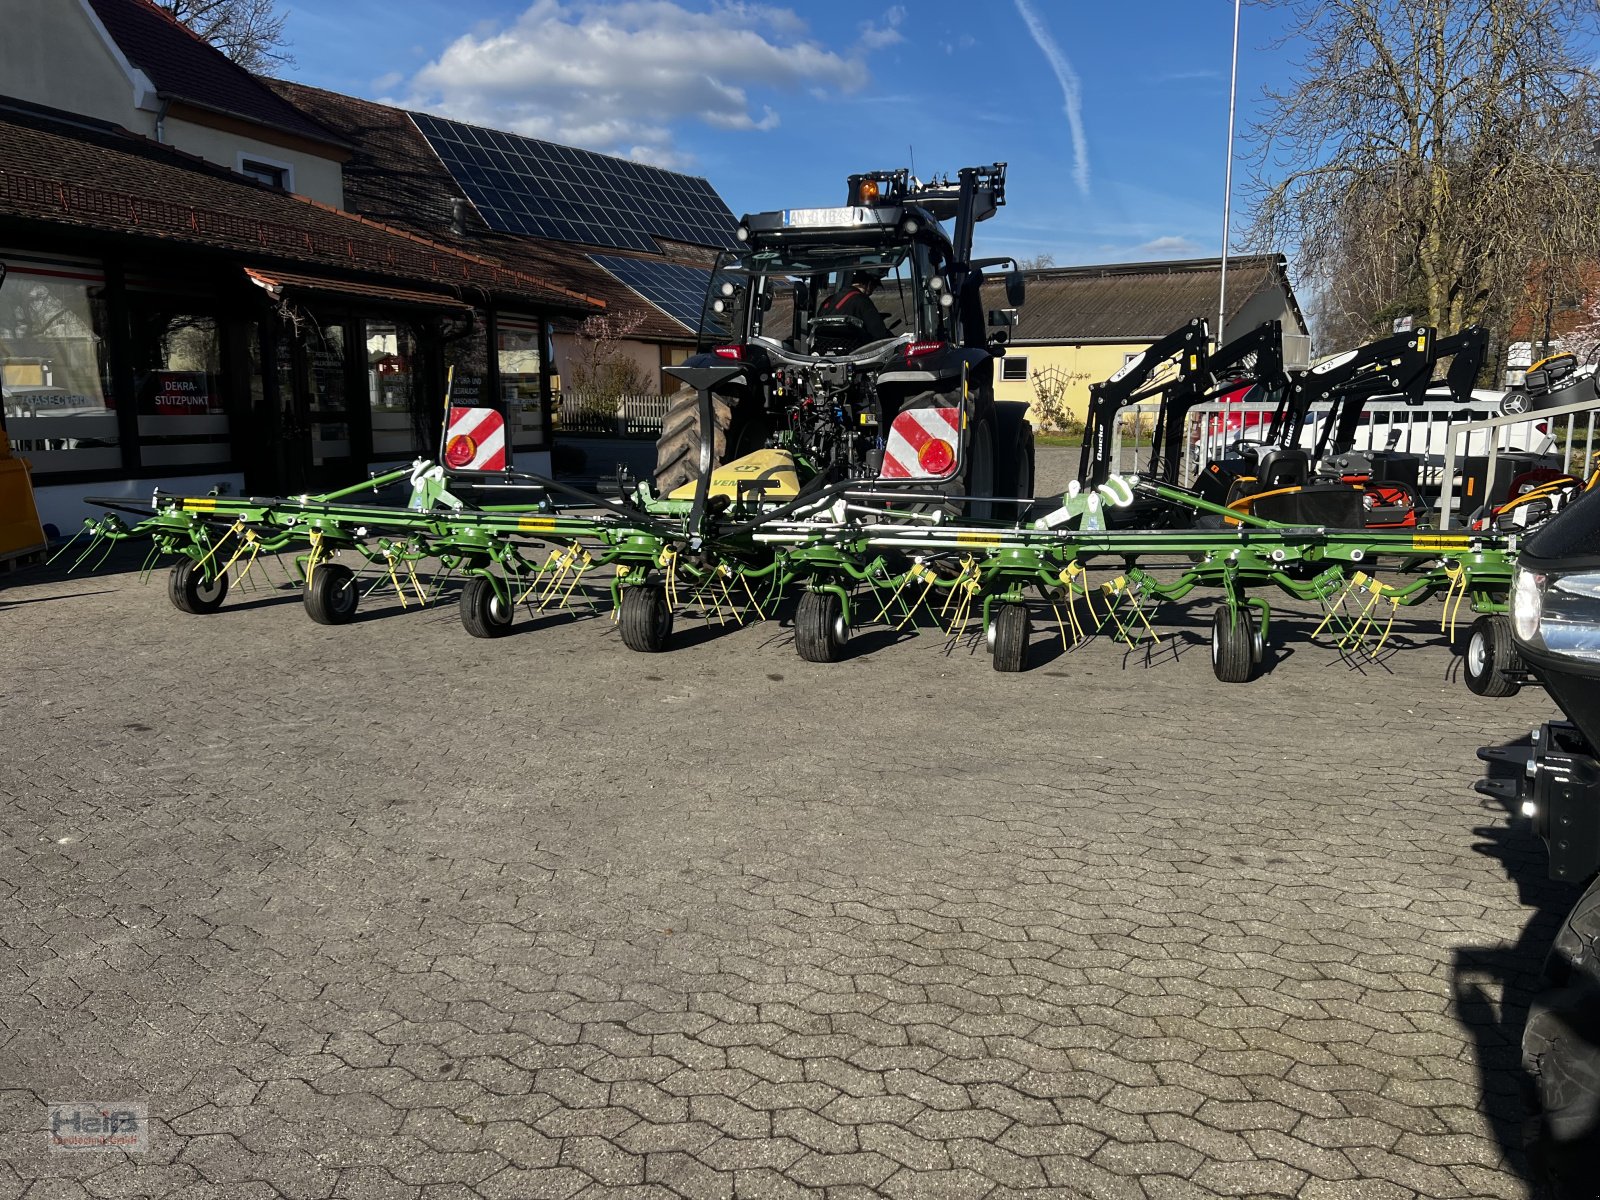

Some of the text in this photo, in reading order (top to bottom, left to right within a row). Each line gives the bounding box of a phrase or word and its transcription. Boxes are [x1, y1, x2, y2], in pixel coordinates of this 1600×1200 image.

[165, 381, 197, 391] DEKRA-
[155, 393, 208, 405] STÜTZPUNKT
[1283, 411, 1297, 448] Quicke
[1096, 423, 1104, 461] Quicke
